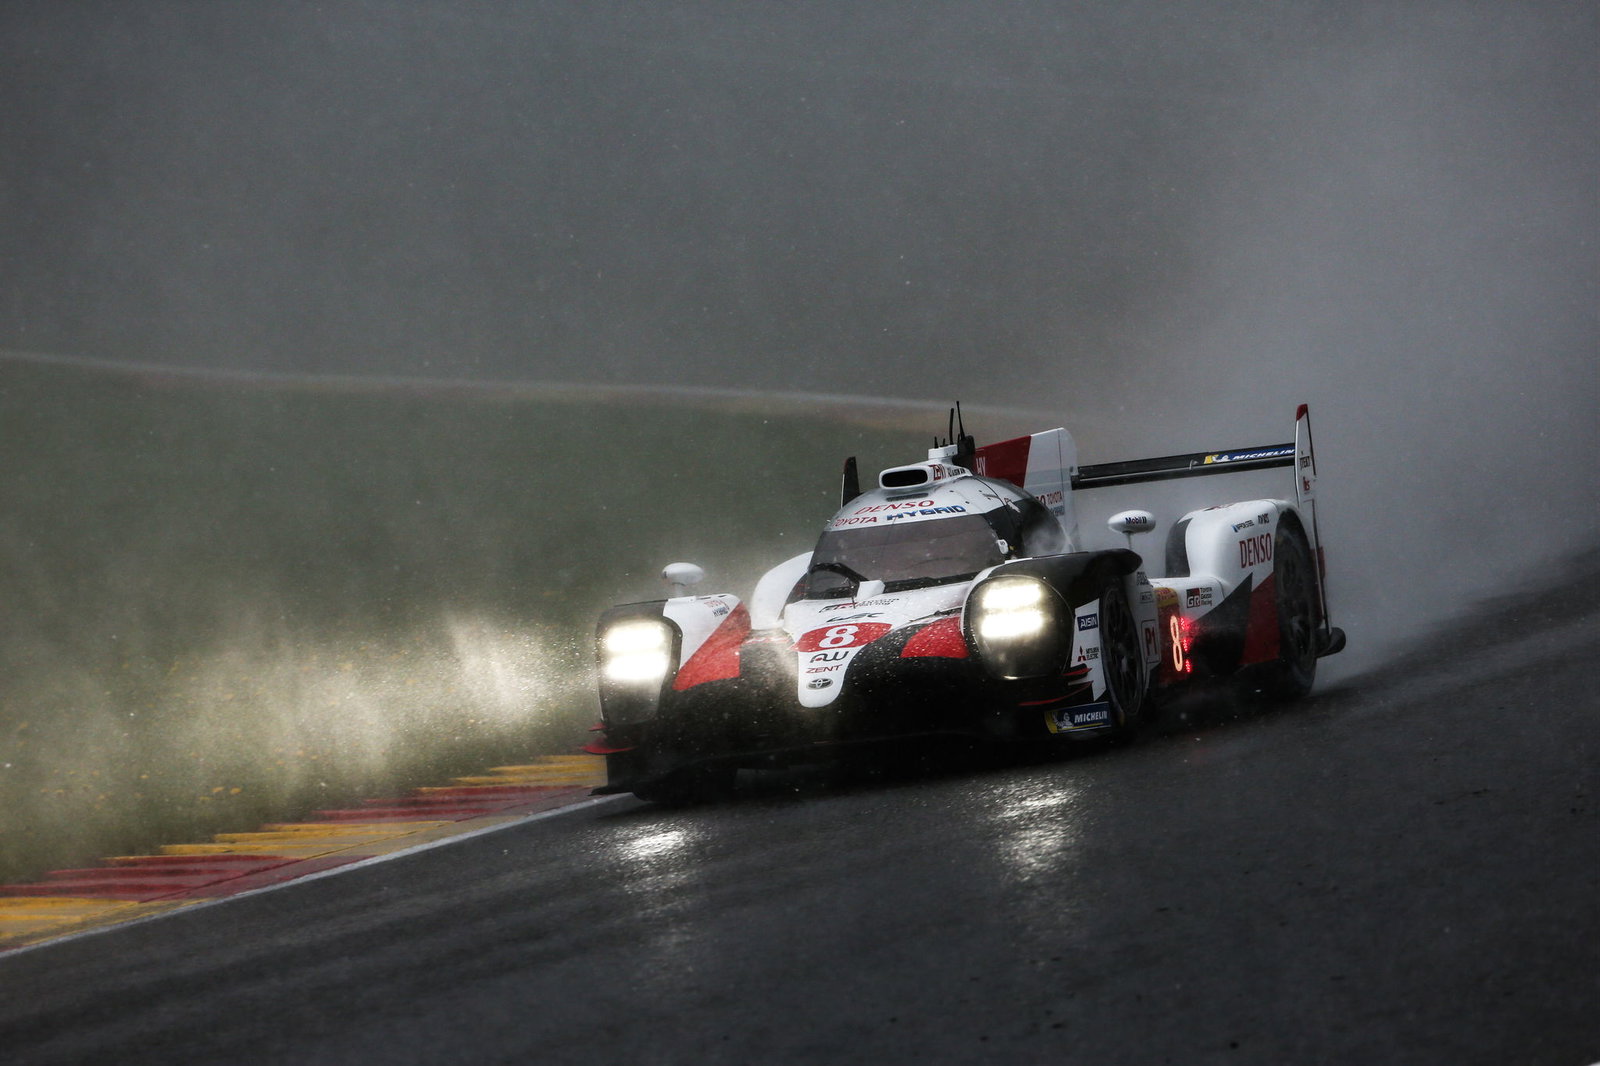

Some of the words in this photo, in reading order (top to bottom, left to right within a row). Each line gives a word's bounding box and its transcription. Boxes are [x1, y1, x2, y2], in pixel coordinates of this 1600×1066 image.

[1232, 449, 1295, 460] MICHELIN
[855, 500, 935, 515] DENSO
[832, 517, 878, 527] TOYOTA
[886, 505, 967, 521] HYBRID
[1239, 533, 1273, 569] DENSO
[1187, 595, 1200, 607] GR
[818, 625, 860, 648] 8
[1170, 615, 1183, 672] 8
[806, 664, 843, 674] ZENT
[1074, 710, 1108, 724] MICHELIN
